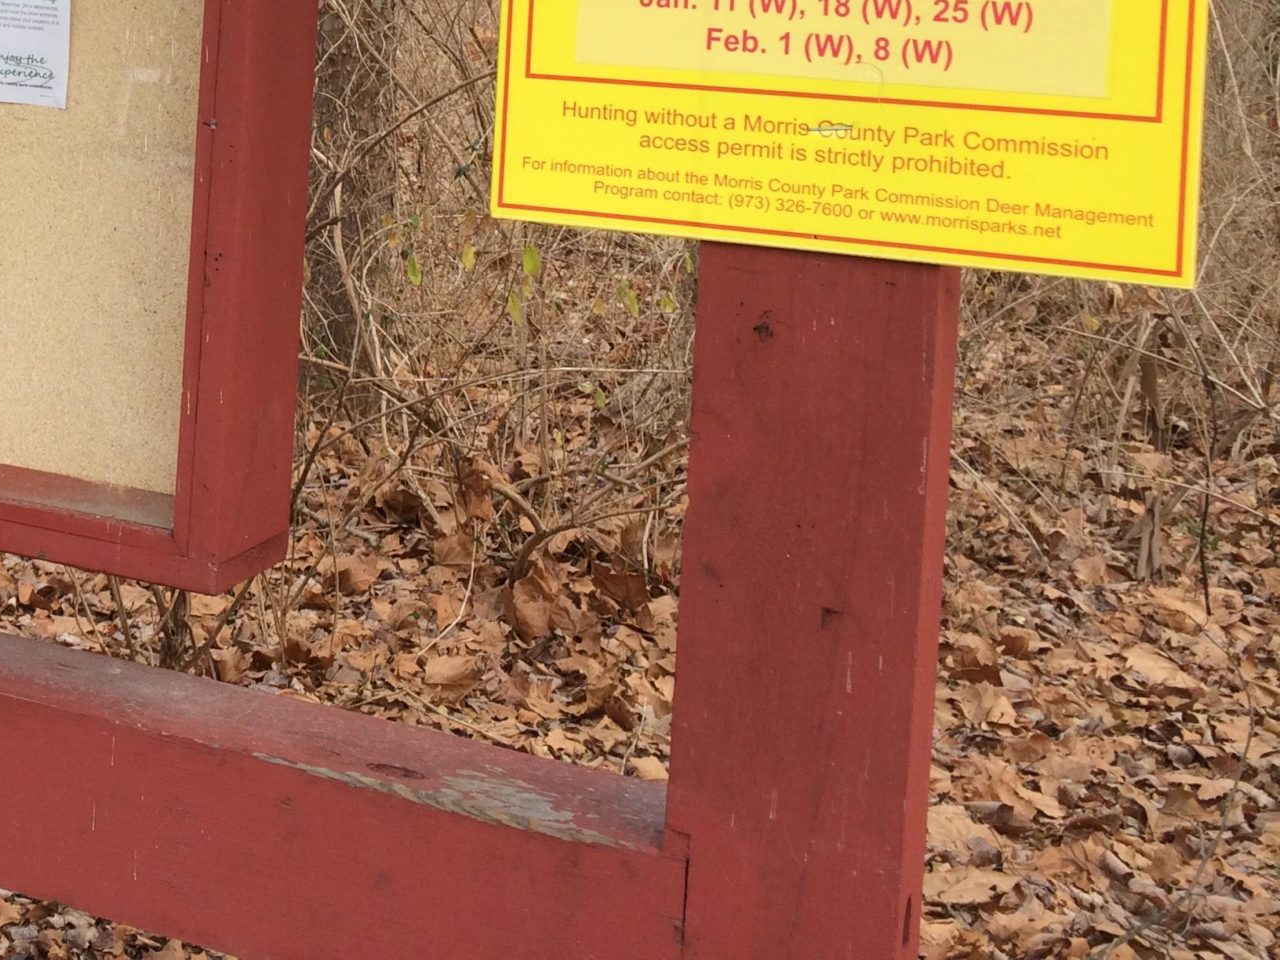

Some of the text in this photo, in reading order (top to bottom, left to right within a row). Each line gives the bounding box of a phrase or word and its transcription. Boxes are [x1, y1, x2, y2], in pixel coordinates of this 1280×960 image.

[980, 0, 1034, 33] (W)
[27, 54, 46, 65] the
[706, 27, 953, 72] Feb. 1 (W), 8 (W)
[563, 100, 1108, 161] Hunting without a Morris County Park Commission
[639, 135, 1010, 179] access permit is strictly prohibited.
[523, 156, 1154, 227] For information about the Morris County Park Commission Deer Management
[594, 181, 1061, 238] Program contact: (973) 326-7600 or www.morrisparks.net
